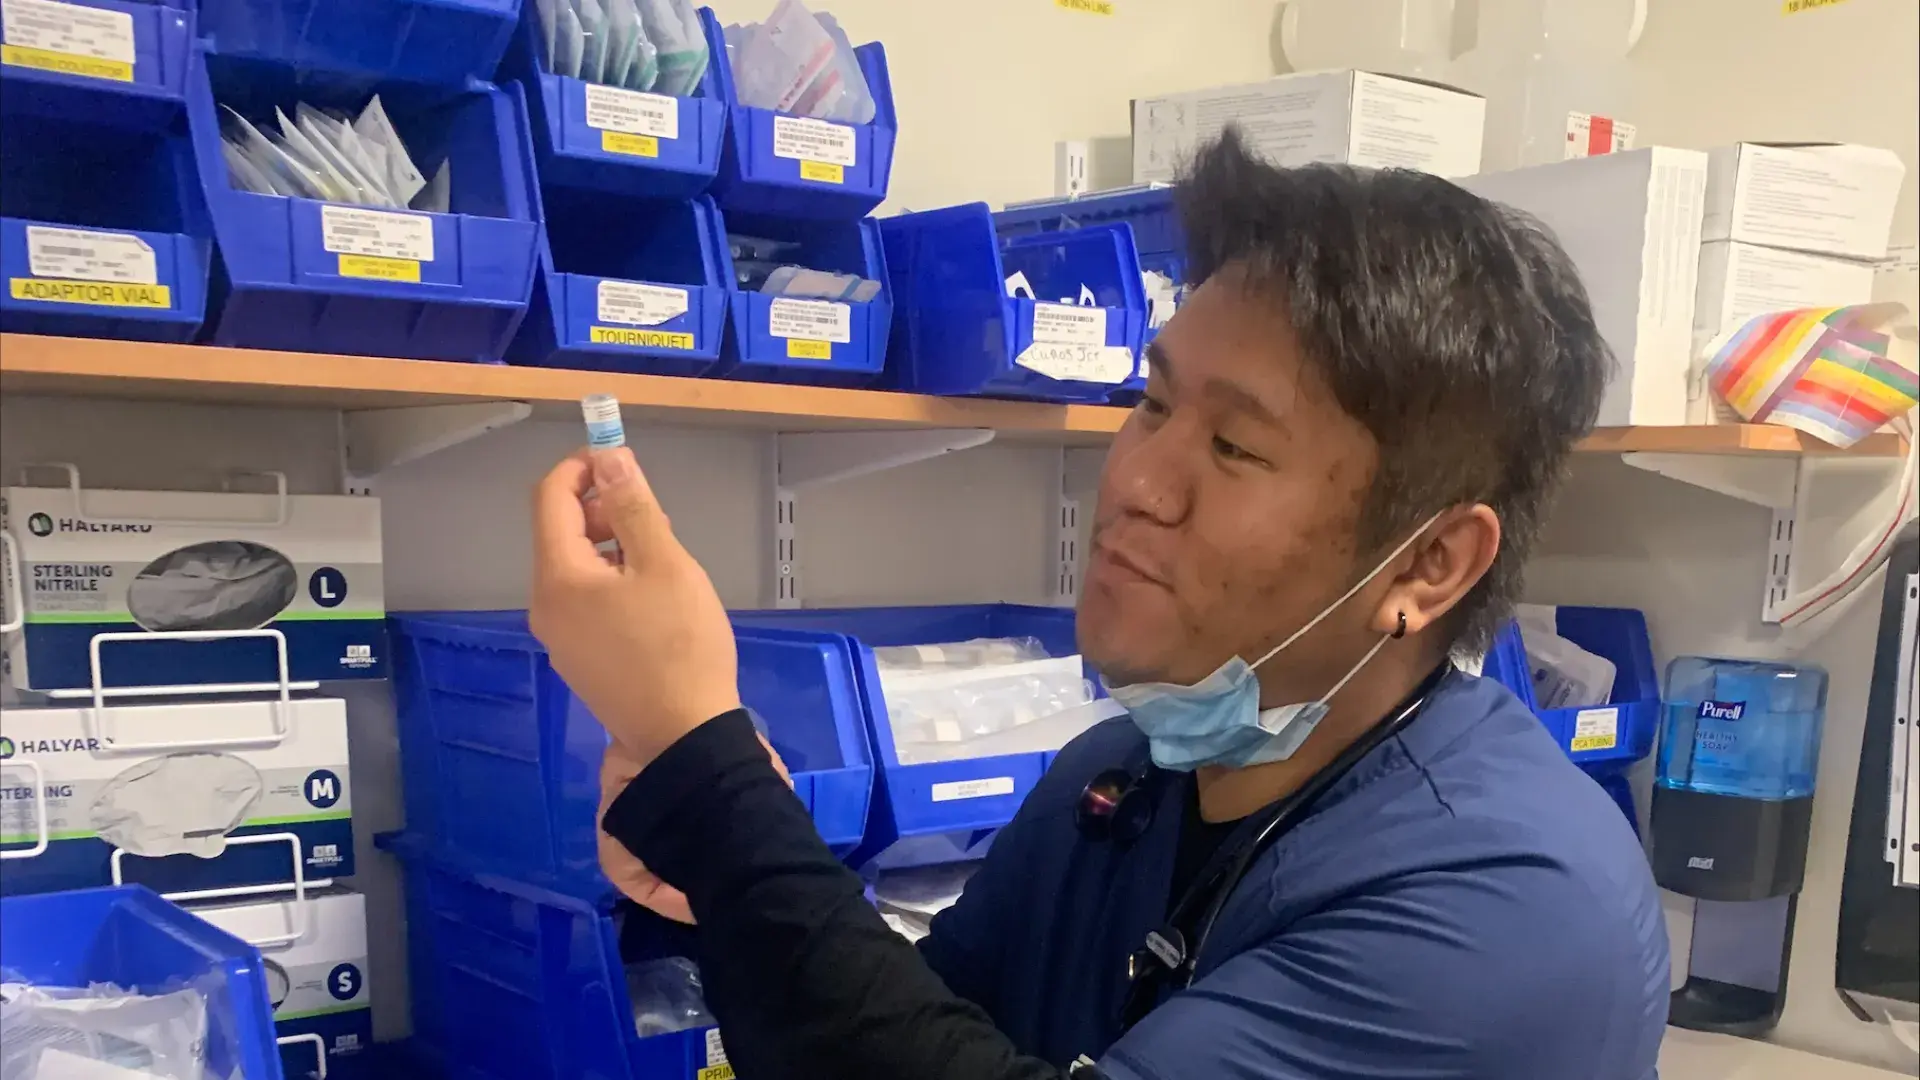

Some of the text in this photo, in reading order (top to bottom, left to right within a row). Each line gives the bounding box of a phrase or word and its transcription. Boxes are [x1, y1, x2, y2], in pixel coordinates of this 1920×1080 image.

[22, 282, 161, 304] ADAPTOR VIAL
[597, 329, 688, 349] TOURNIQUET
[33, 564, 114, 577] STERLING
[35, 579, 99, 591] NITRILE
[320, 576, 337, 600] L
[1701, 701, 1742, 720] Purell
[312, 777, 335, 801] M
[338, 971, 353, 993] S
